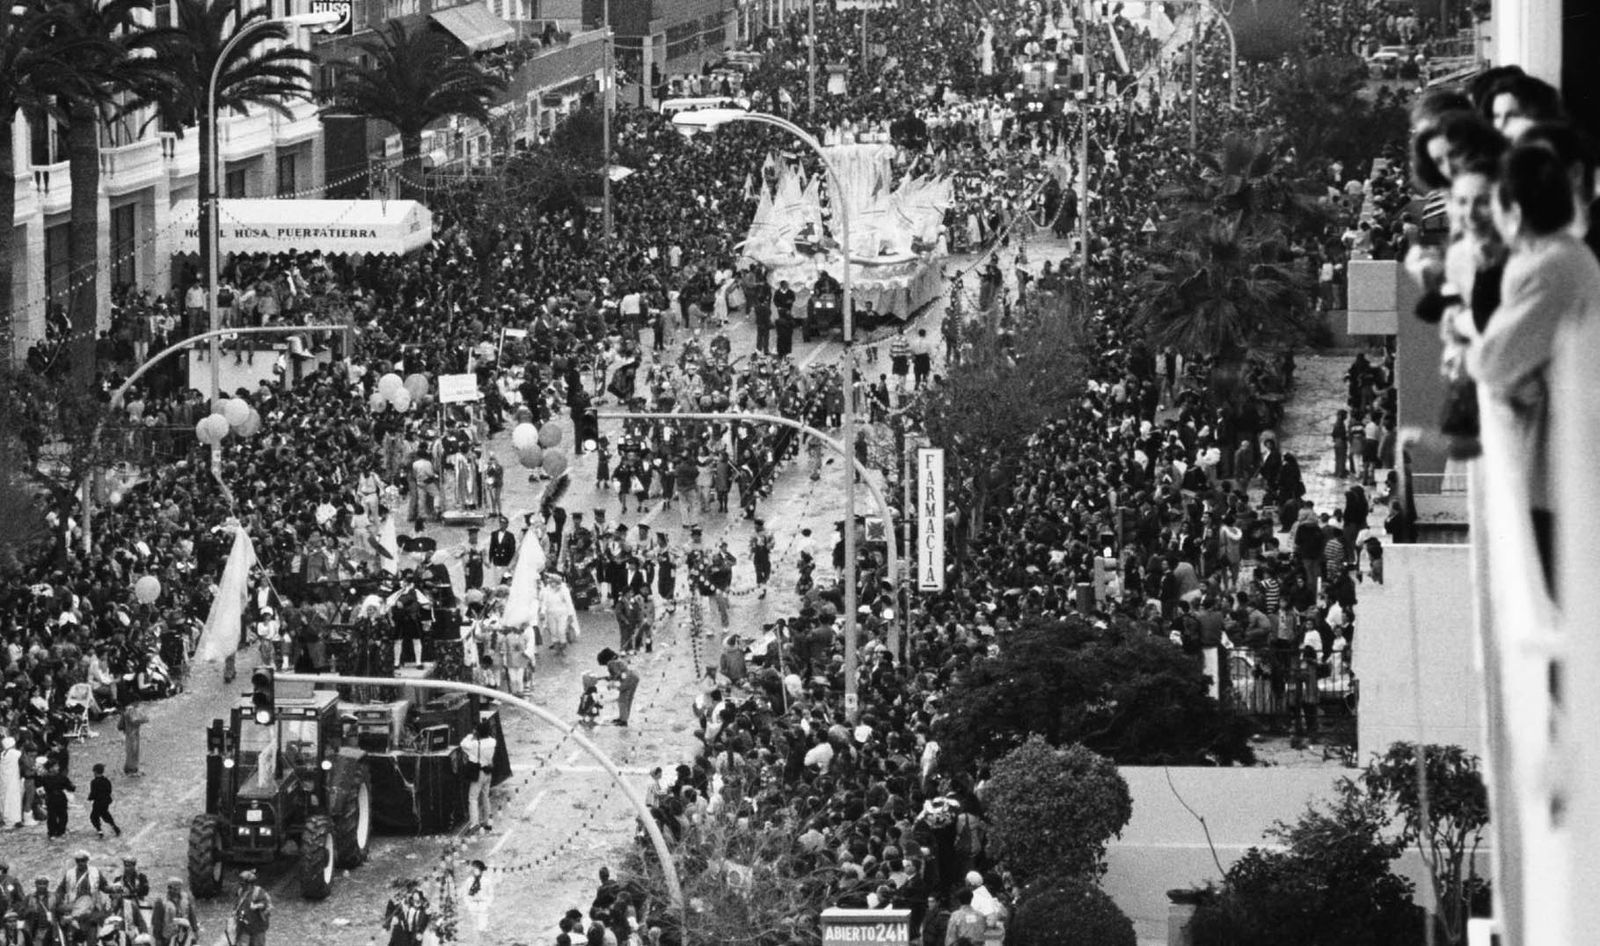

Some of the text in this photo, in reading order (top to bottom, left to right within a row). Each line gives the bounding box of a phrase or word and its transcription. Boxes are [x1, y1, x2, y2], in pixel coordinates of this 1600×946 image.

[313, 2, 350, 15] HUSA
[185, 228, 377, 238] HOL HUSA PUERTATIERRA
[925, 454, 936, 582] FARMACIA
[825, 923, 908, 942] ABIERTO 24H
